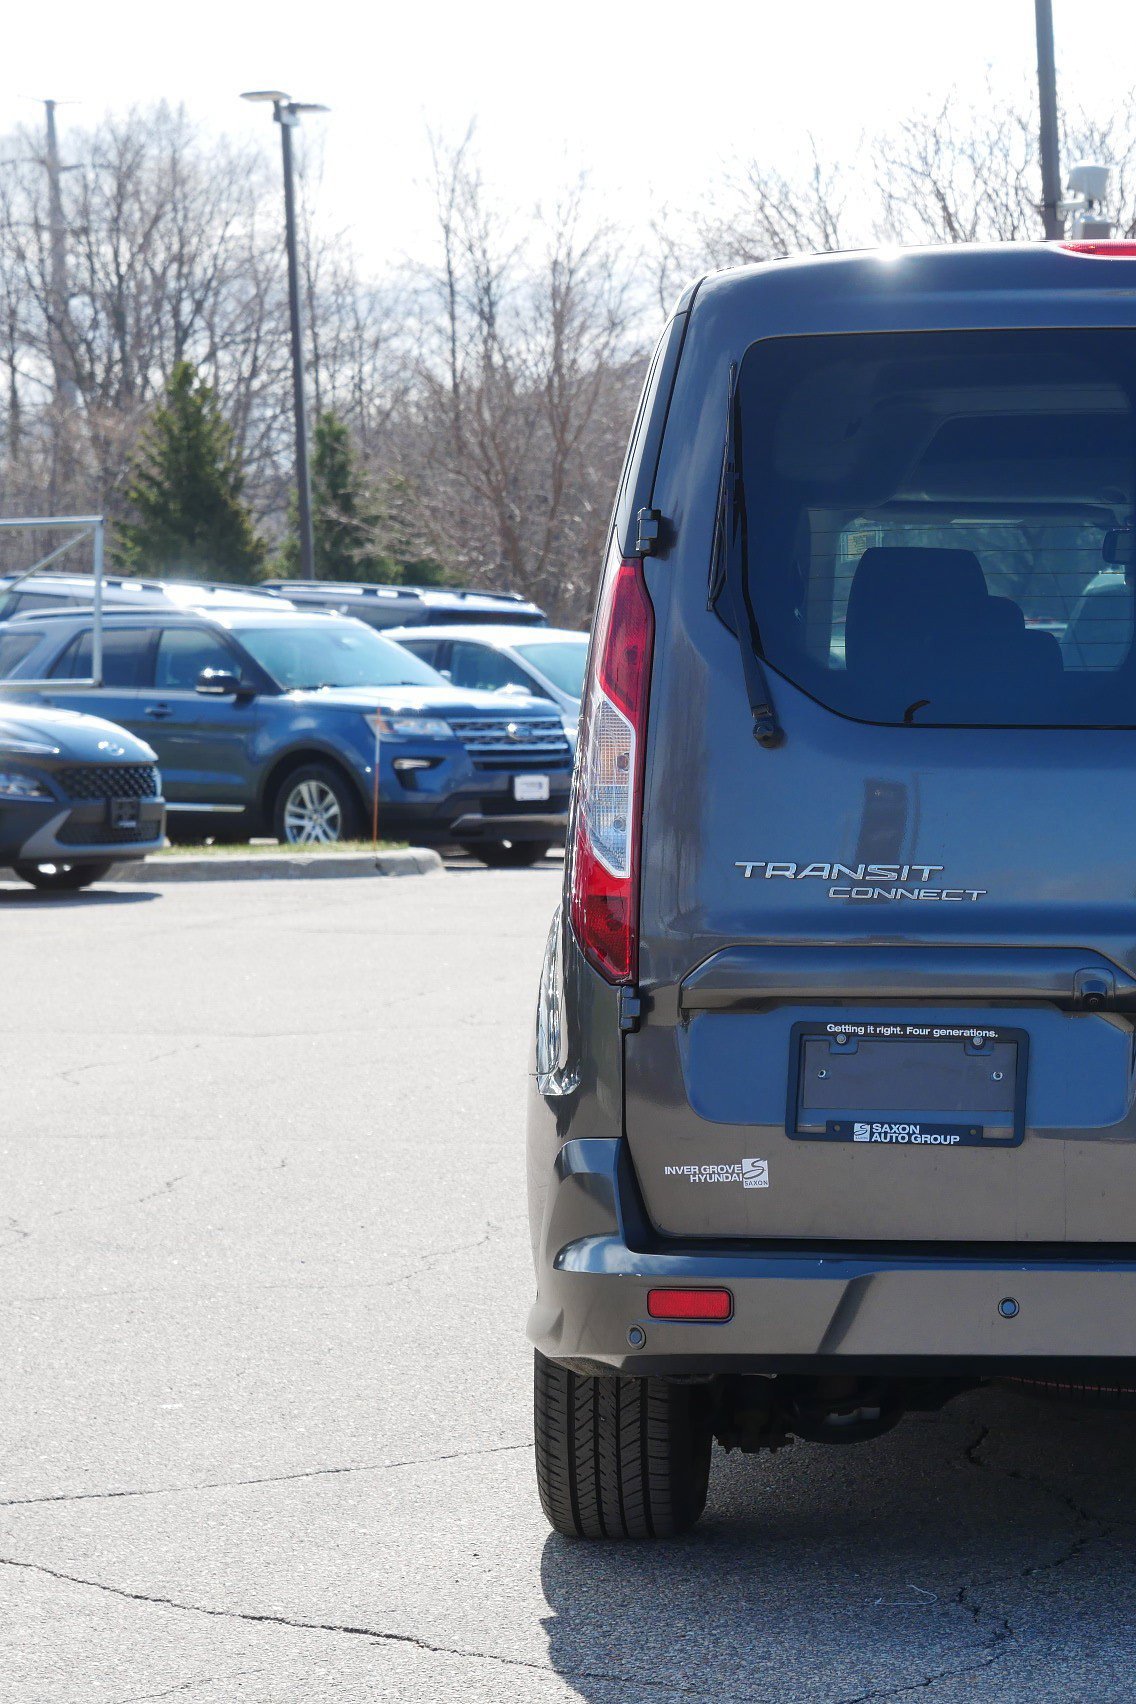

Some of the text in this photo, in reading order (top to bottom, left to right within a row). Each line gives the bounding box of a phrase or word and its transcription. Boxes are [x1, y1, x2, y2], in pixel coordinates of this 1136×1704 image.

[734, 861, 944, 882] TRANSIT
[828, 886, 987, 901] CONNECT
[826, 1023, 999, 1038] Getting it right. Four generations.
[872, 1123, 920, 1134] SAXON
[871, 1132, 960, 1145] AUTO GROUP
[664, 1164, 742, 1175] INVER GROVE
[690, 1173, 742, 1183] HYUNDAI
